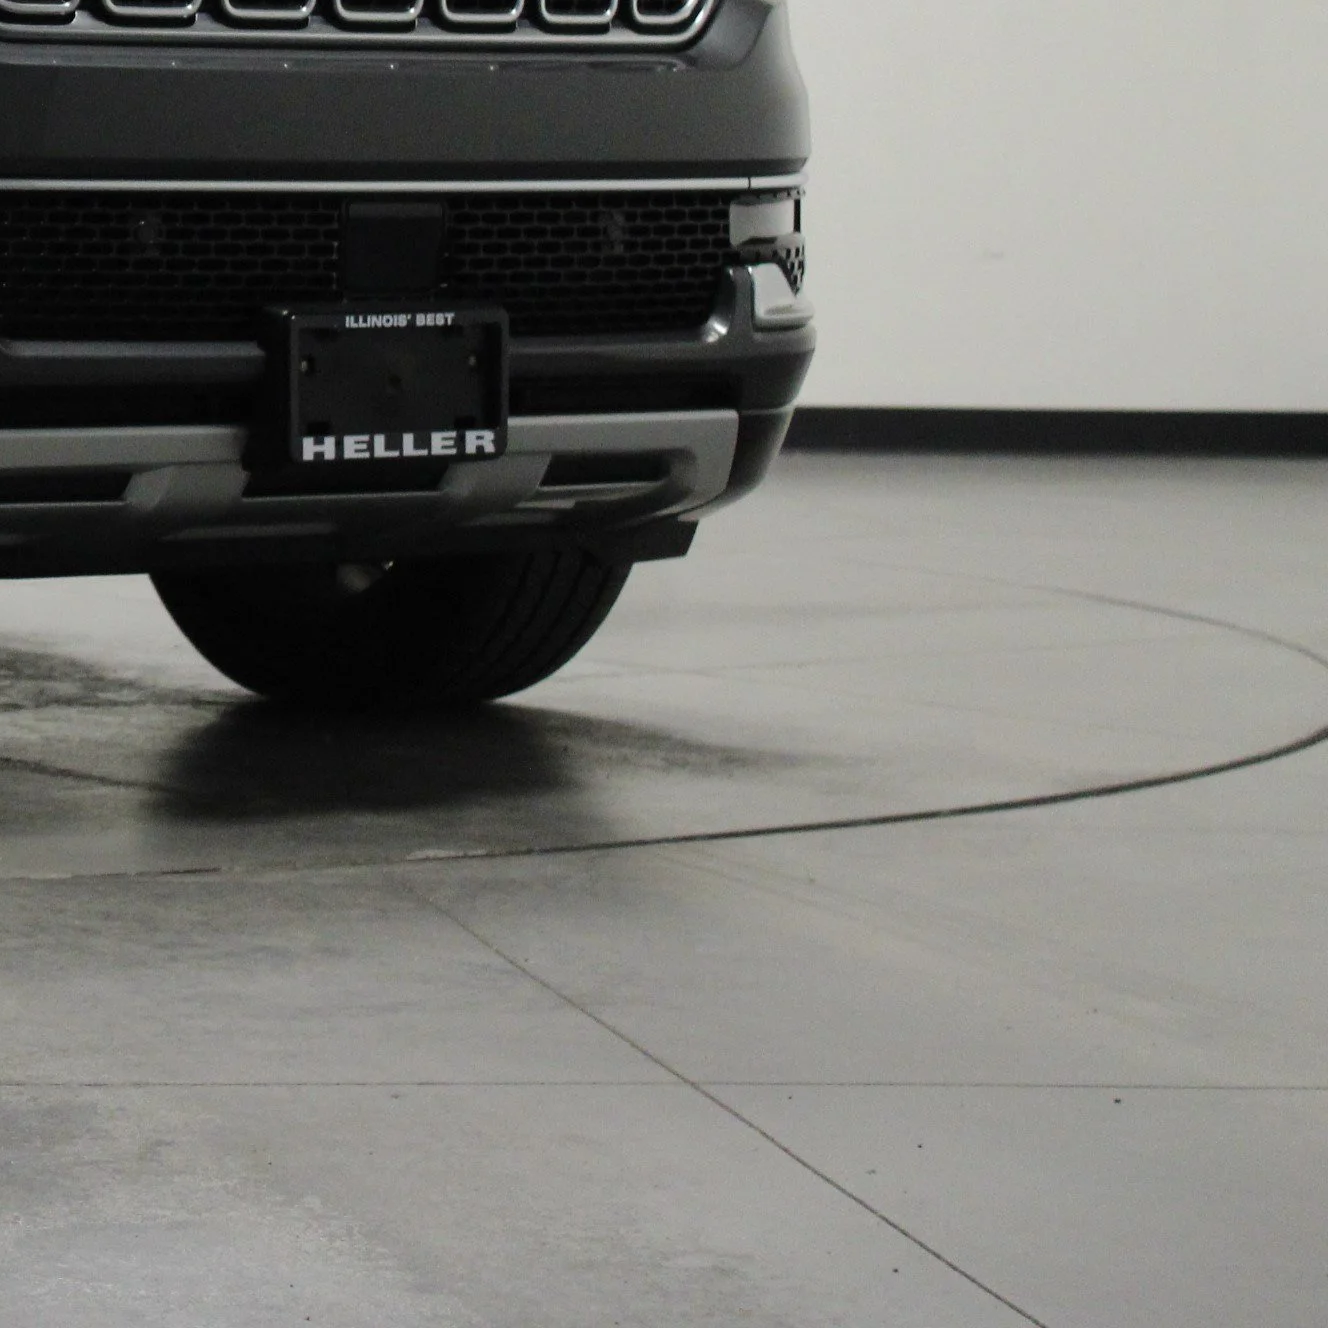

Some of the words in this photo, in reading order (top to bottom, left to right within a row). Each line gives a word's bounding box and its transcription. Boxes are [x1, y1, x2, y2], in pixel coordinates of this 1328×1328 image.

[345, 313, 412, 328] ILLINOIS'
[416, 312, 456, 326] BEST
[302, 429, 496, 461] HELLER
